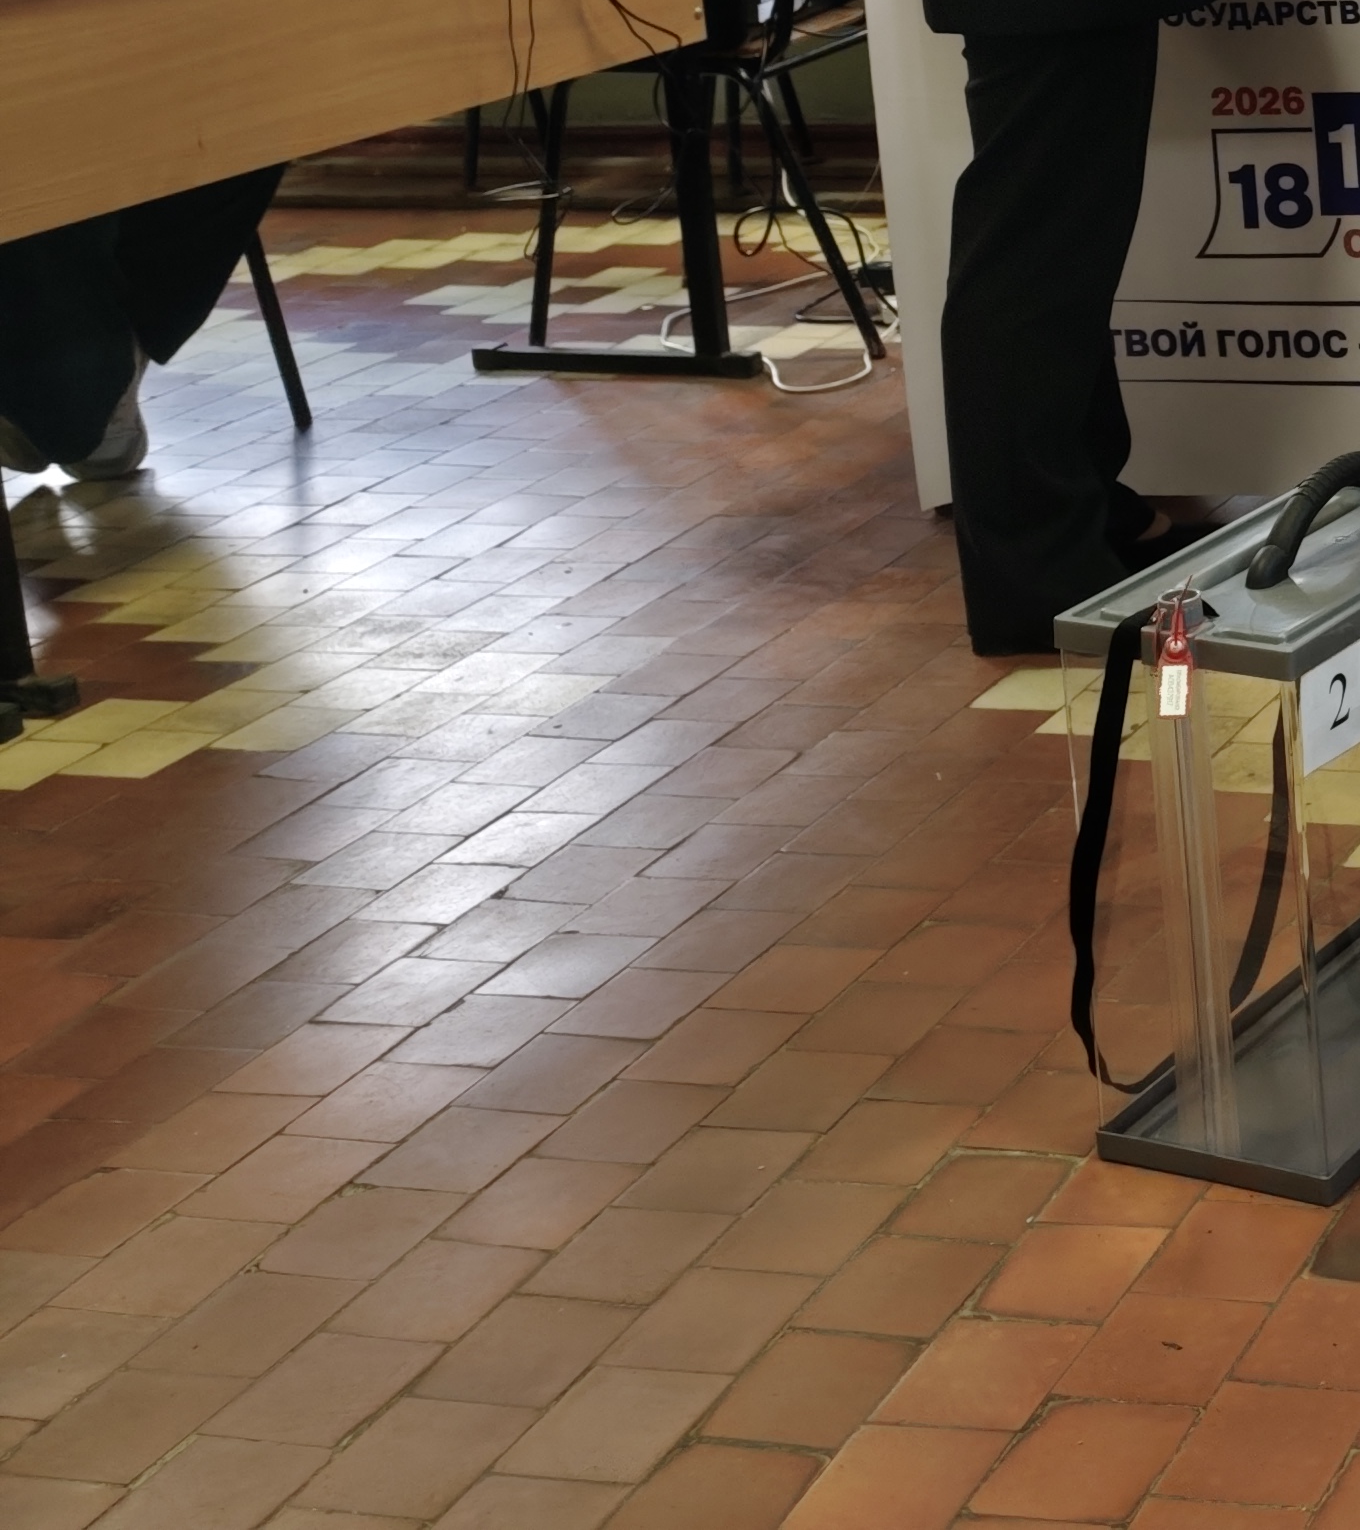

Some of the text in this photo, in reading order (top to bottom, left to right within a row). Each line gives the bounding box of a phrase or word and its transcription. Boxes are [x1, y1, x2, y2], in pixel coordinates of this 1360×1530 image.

[1211, 86, 1305, 116] 2026
[1228, 162, 1313, 230] 18
[1217, 329, 1348, 359] ГОЛОС
[1328, 672, 1351, 731] 2
